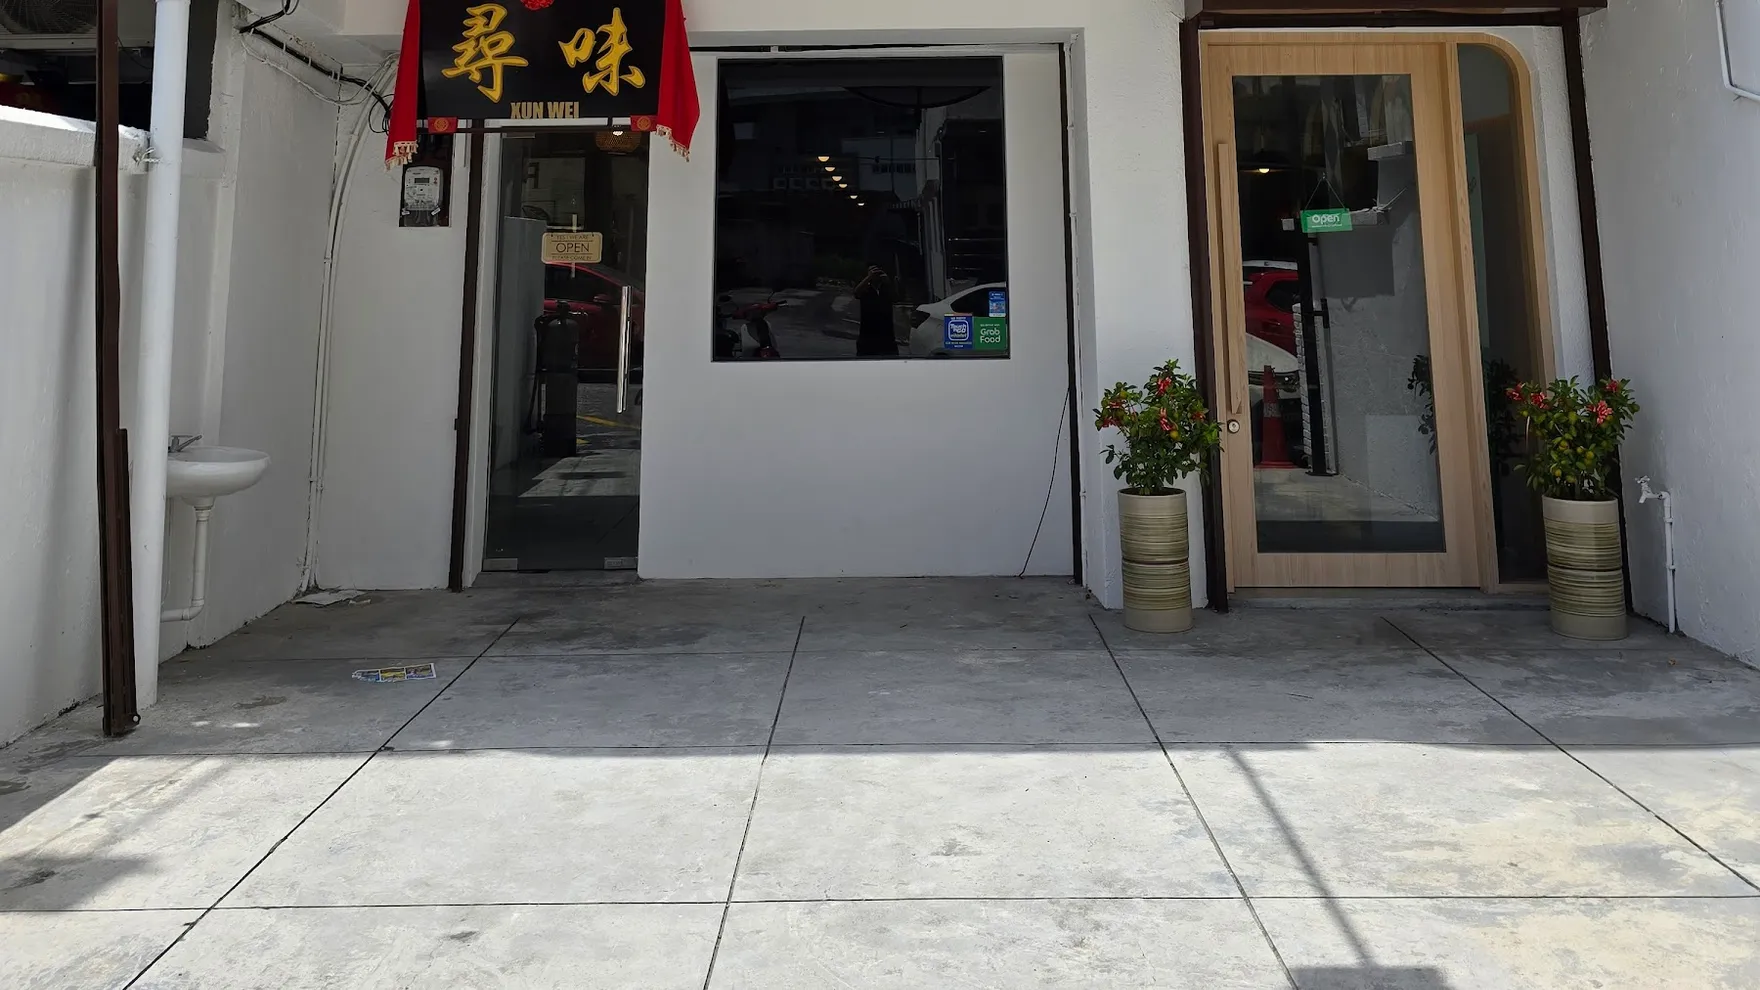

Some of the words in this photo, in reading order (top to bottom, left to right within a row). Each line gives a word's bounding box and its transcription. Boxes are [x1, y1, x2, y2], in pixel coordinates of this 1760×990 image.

[441, 3, 646, 103] 尋味
[510, 102, 543, 119] XUN
[548, 101, 579, 119] WEI
[555, 242, 590, 253] OPEN
[980, 328, 1000, 336] Grab
[980, 335, 1001, 343] Food
